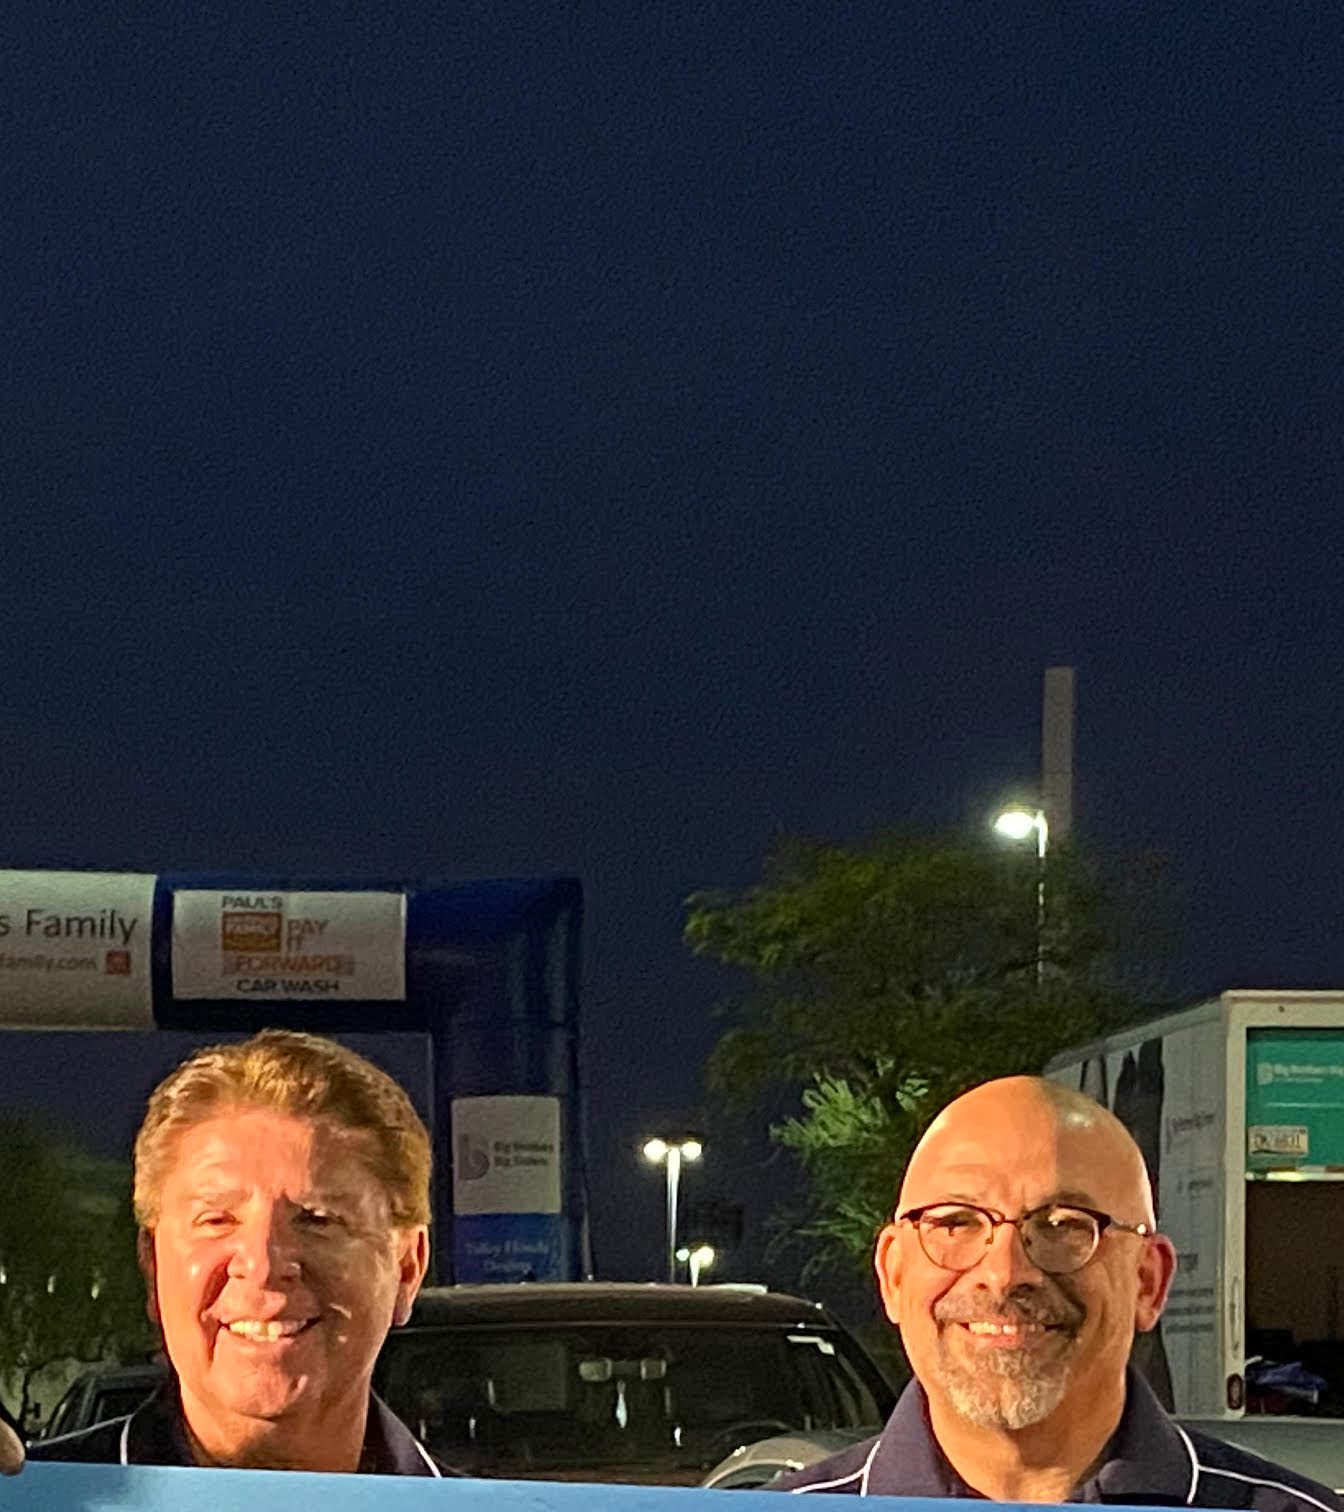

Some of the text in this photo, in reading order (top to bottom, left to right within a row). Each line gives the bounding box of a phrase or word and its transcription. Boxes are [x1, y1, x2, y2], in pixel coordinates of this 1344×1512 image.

[25, 909, 137, 945] Family
[287, 920, 329, 936] PAY
[236, 979, 339, 994] CAR WASH
